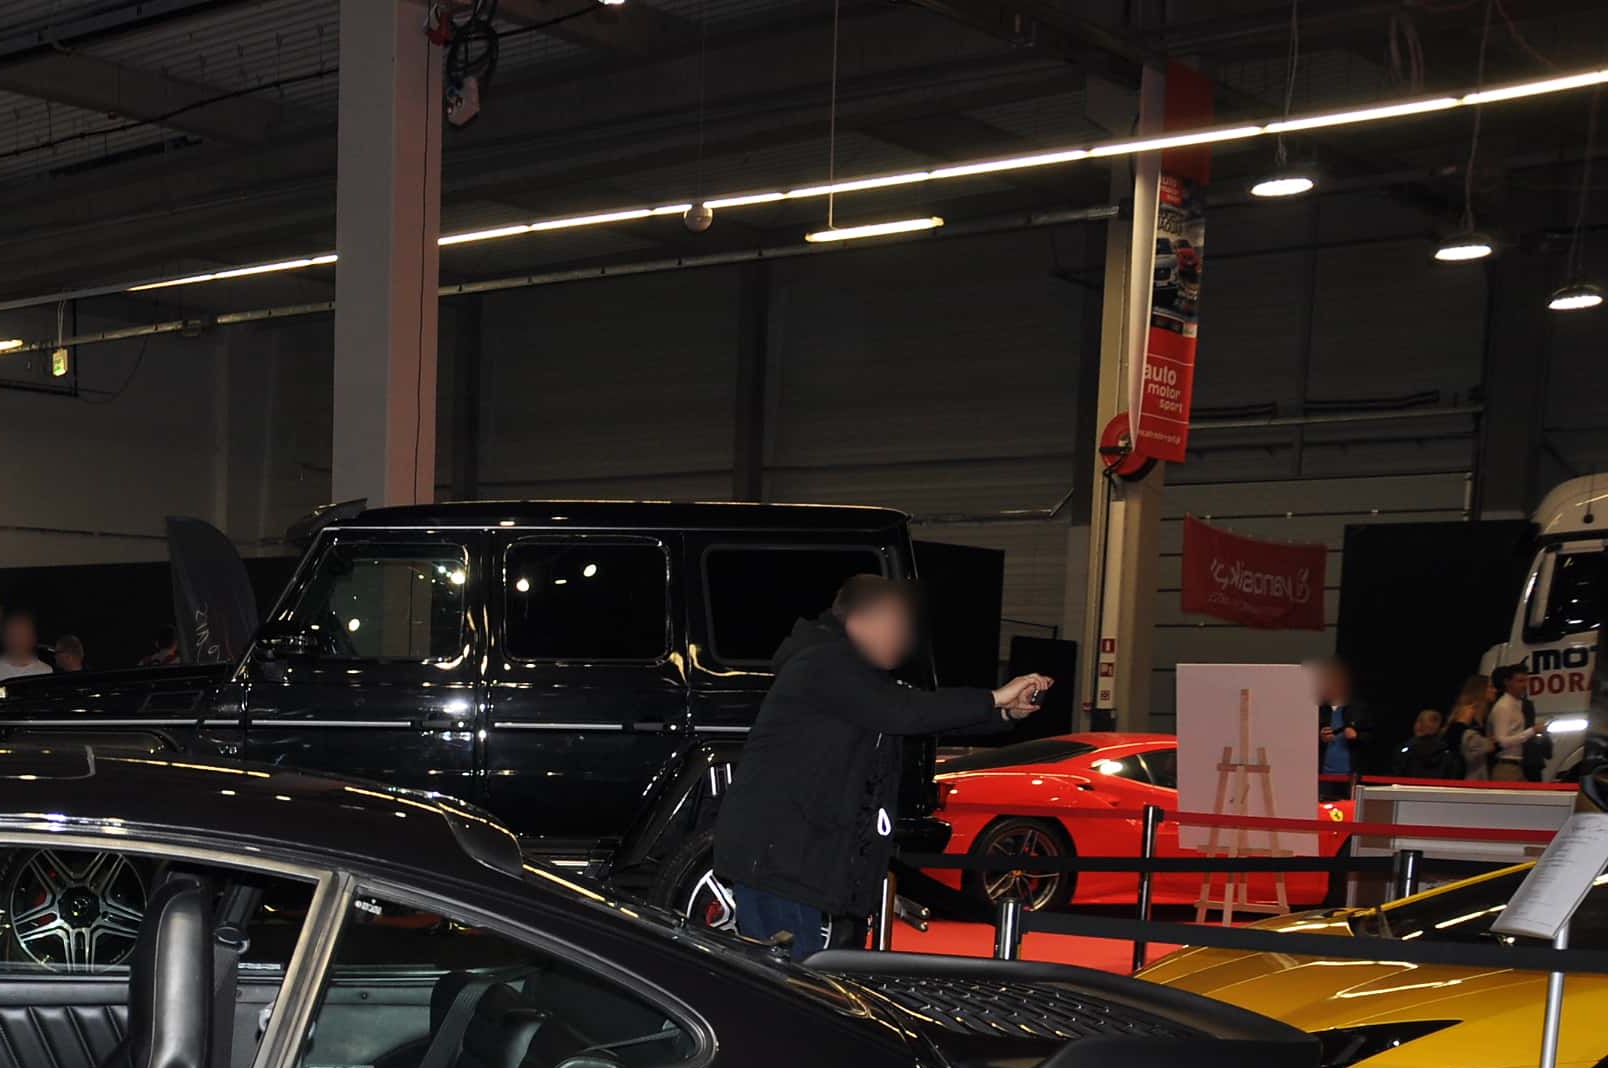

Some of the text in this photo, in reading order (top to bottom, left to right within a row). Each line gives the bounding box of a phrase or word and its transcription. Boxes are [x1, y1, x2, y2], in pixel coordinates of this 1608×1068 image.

[1144, 362, 1177, 386] auto
[1148, 382, 1181, 400] motor
[1159, 398, 1183, 414] sport
